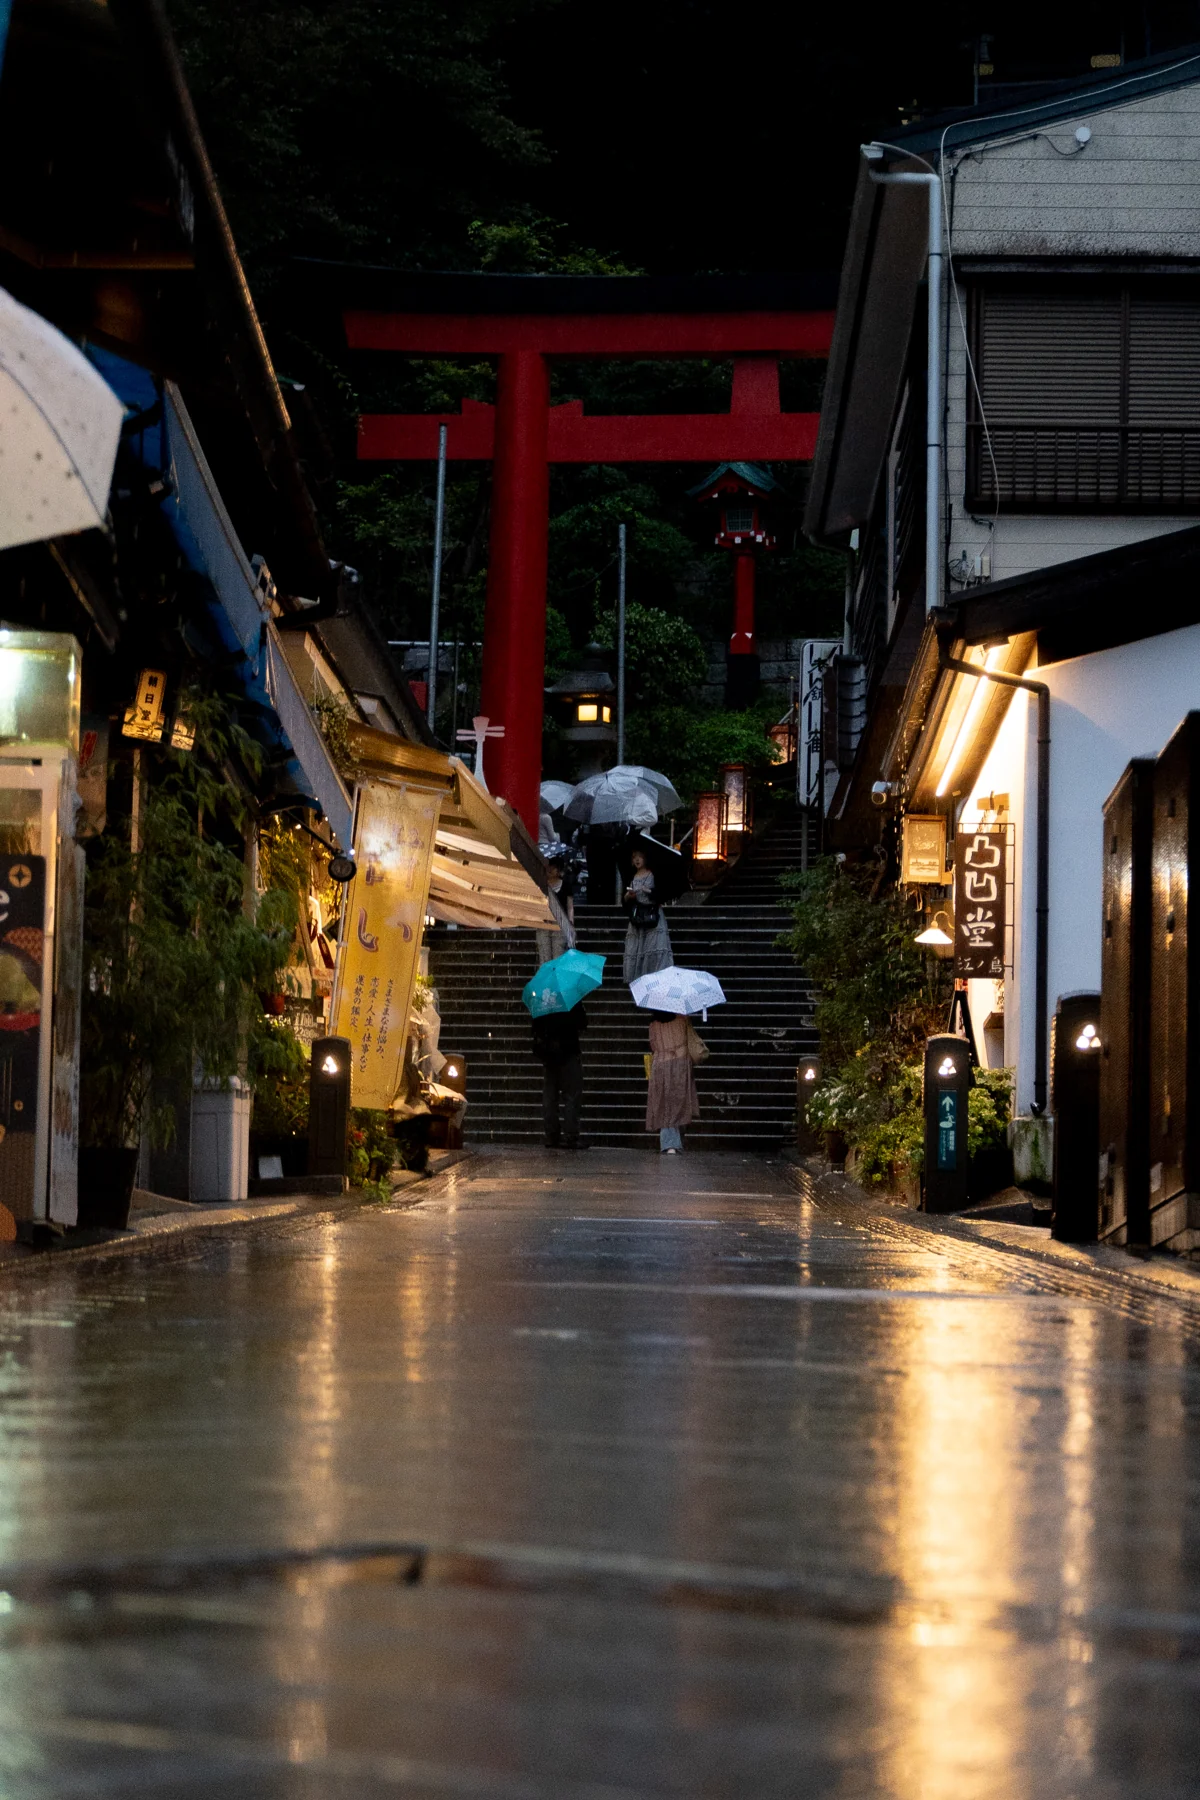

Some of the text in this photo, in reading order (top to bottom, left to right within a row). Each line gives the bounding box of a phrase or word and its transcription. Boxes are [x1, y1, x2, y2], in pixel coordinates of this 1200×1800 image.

[961, 835, 1000, 947] 凸凹堂
[350, 974, 365, 1033] 運勢の鑑定。
[957, 956, 1003, 973] 江ノ島
[359, 976, 379, 1073] 恋愛・人生・仕事など
